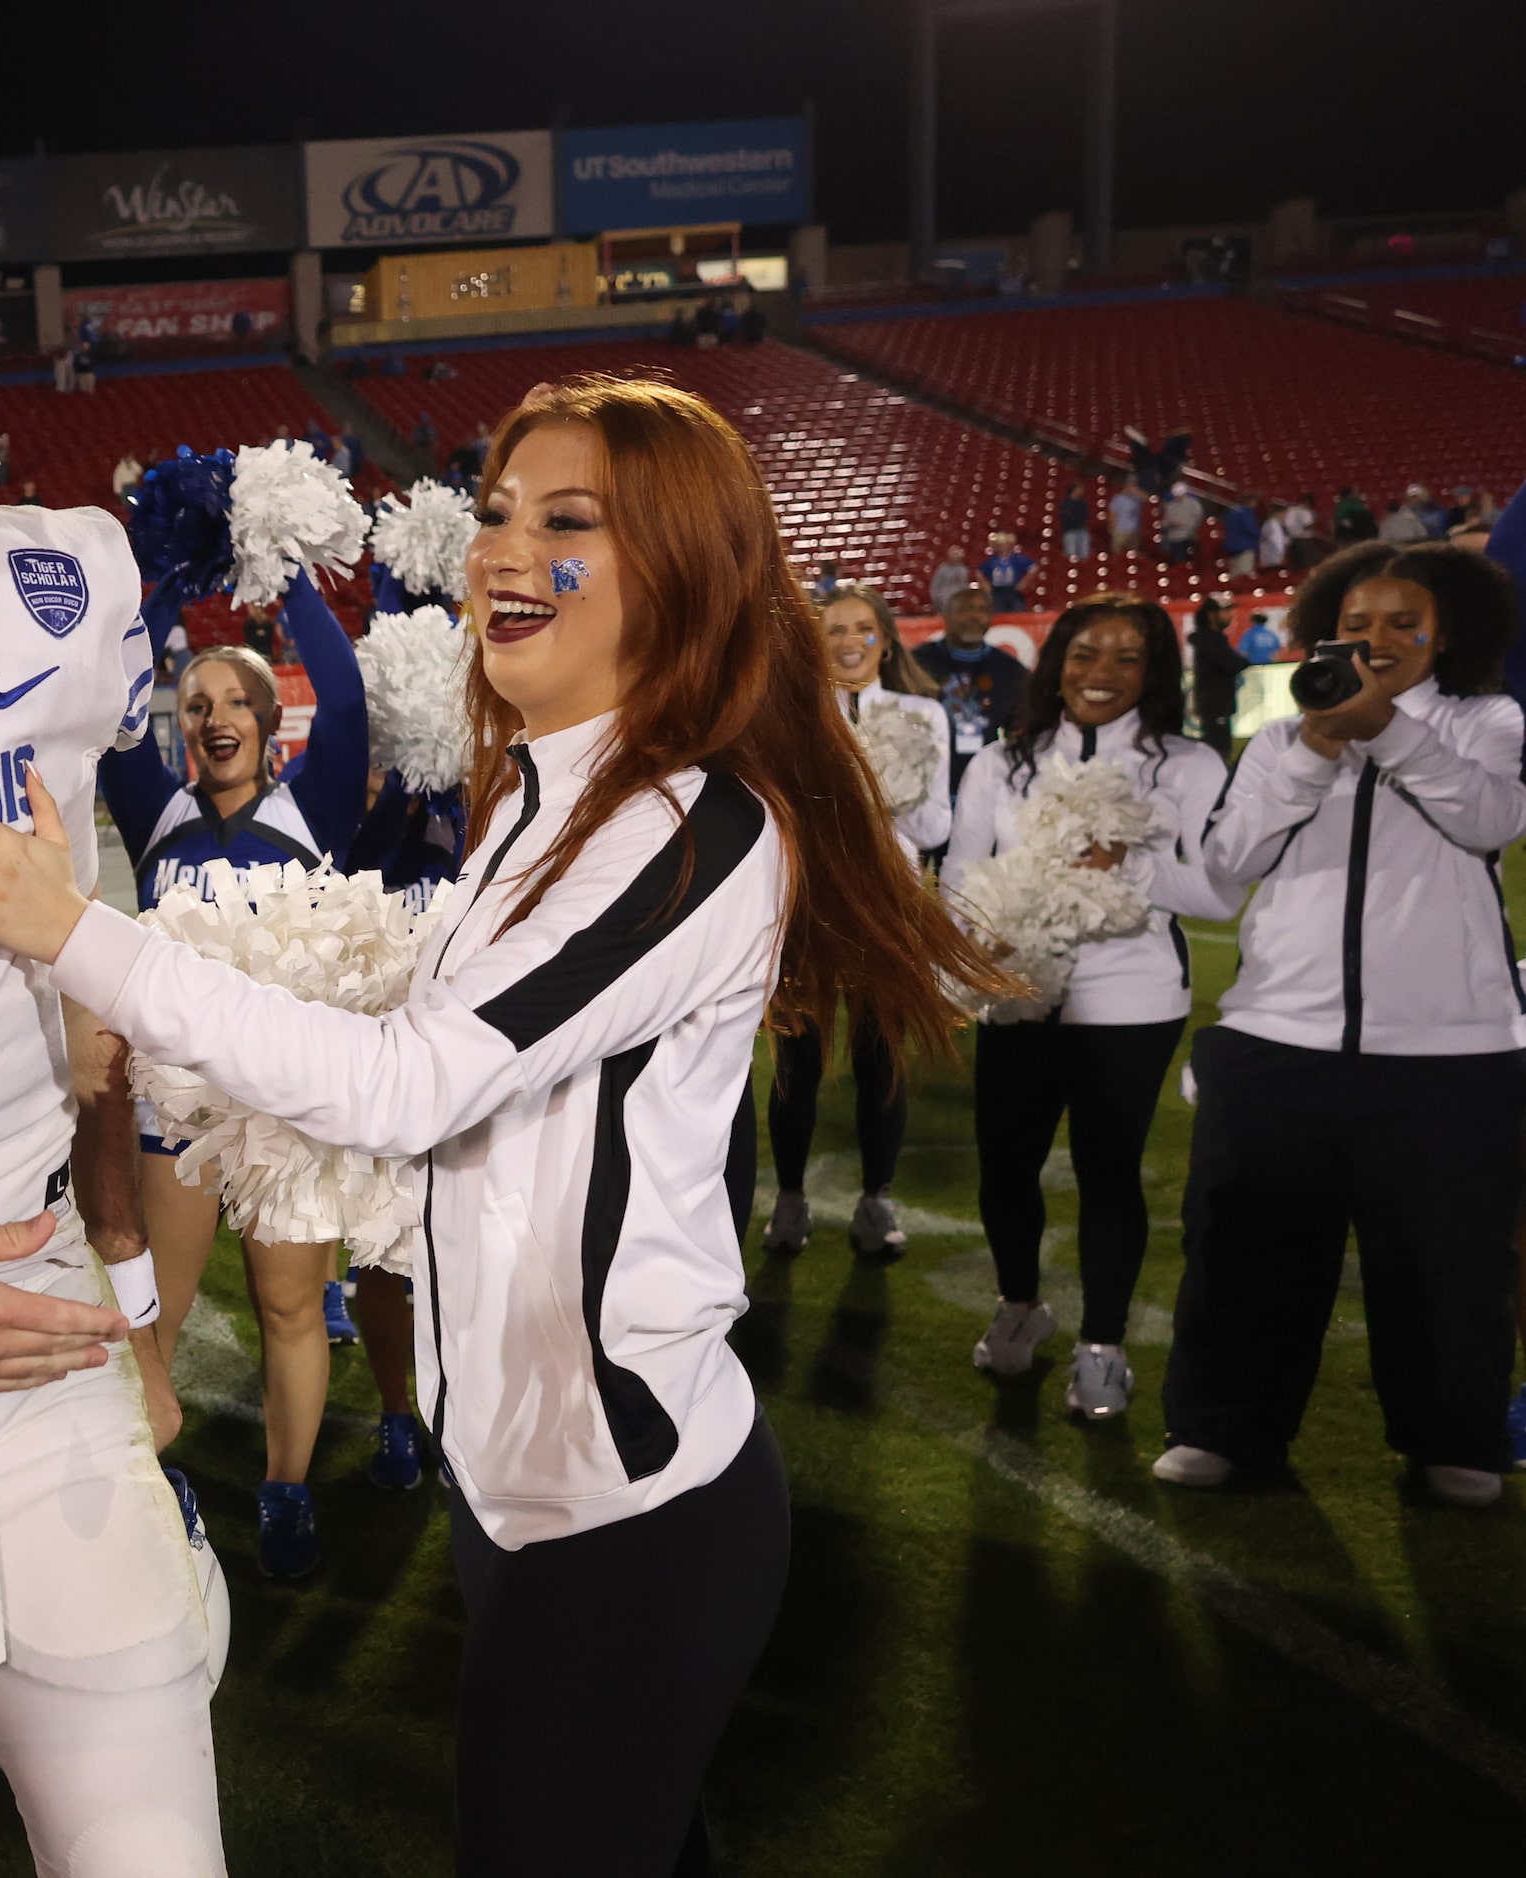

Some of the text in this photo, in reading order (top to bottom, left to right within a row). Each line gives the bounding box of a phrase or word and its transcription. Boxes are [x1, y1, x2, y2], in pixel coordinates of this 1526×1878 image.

[574, 149, 794, 181] UT Southwestern
[102, 160, 240, 232] WinStar
[342, 204, 515, 241] ADVOCARE
[118, 311, 277, 338] FAN SHP
[20, 572, 78, 587] SCHOLAR
[30, 560, 66, 574] TIGER
